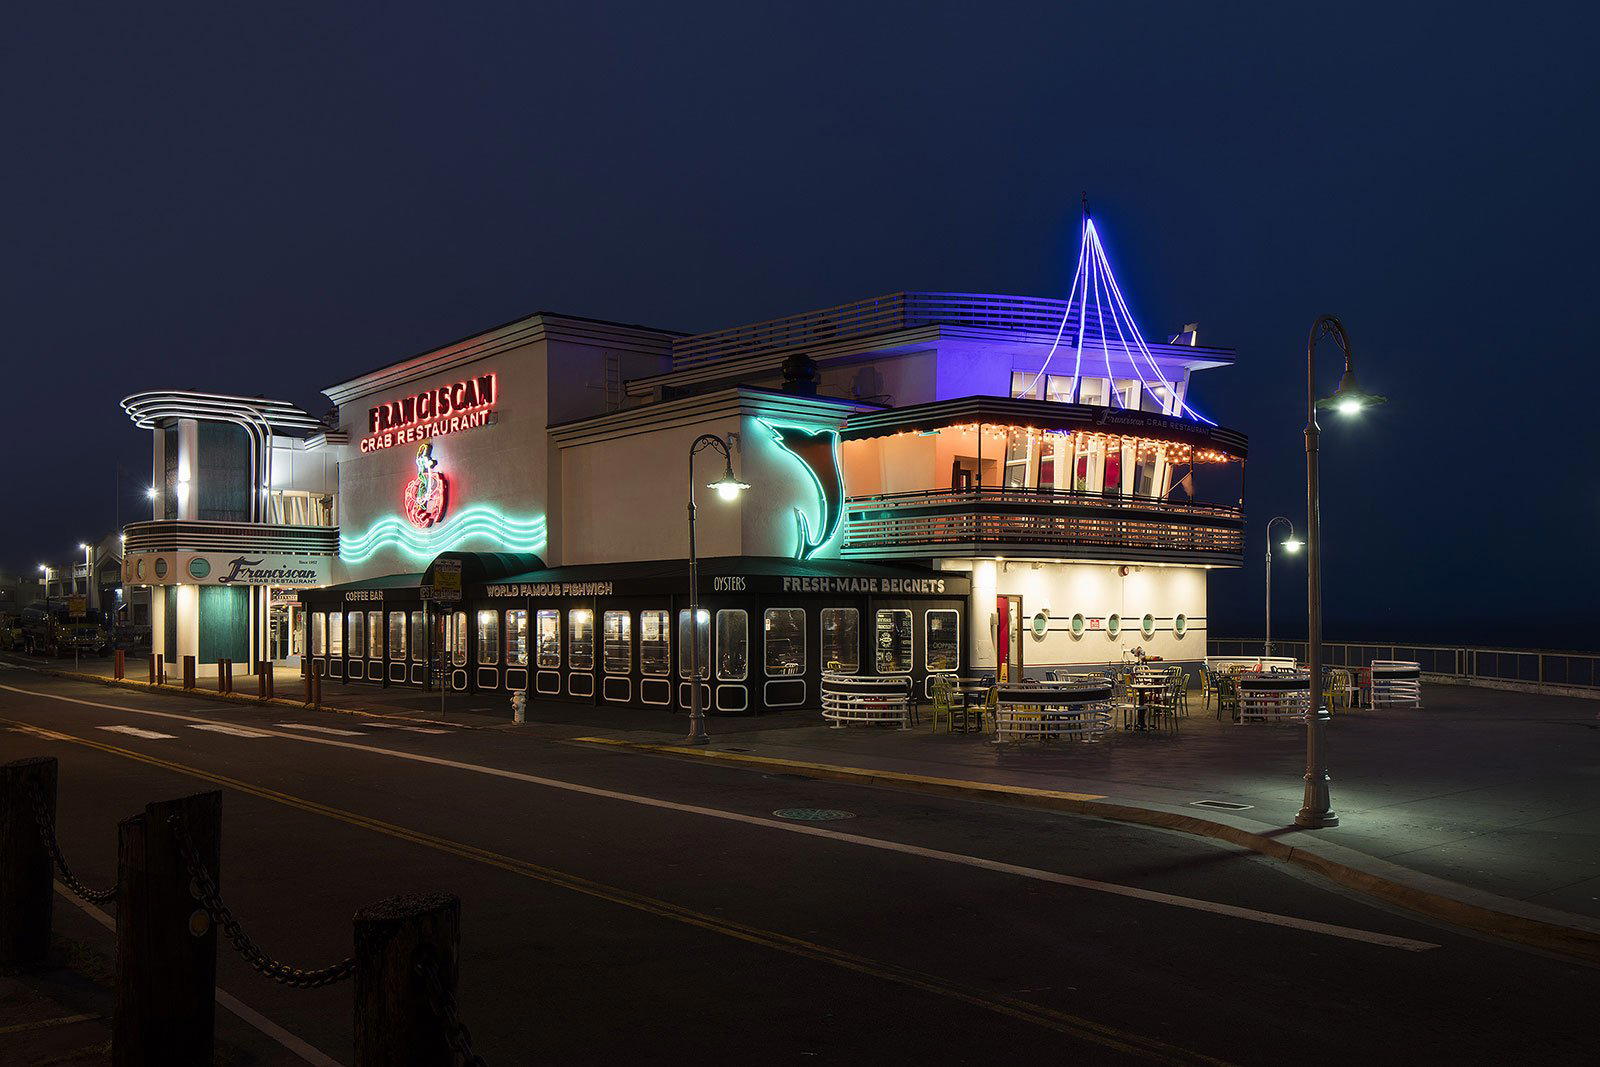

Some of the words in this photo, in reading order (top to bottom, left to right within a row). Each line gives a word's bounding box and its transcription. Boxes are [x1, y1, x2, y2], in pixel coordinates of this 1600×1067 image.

[368, 372, 497, 433] FRANCISCAN
[360, 432, 392, 452] CRAB
[396, 410, 490, 445] RESTAURANT
[1147, 418, 1167, 429] CRAB
[1169, 422, 1210, 436] RESTAURANT
[218, 555, 317, 584] Franciscan
[487, 584, 519, 597] WORLD
[520, 583, 561, 597] FAMOUS
[562, 582, 613, 595] FISHWICH
[714, 576, 746, 591] OYSTERS
[783, 577, 879, 593] FRESH-MADE
[881, 578, 945, 594] BEIGNETS
[345, 591, 369, 601] COFFEE
[370, 590, 384, 601] BAR
